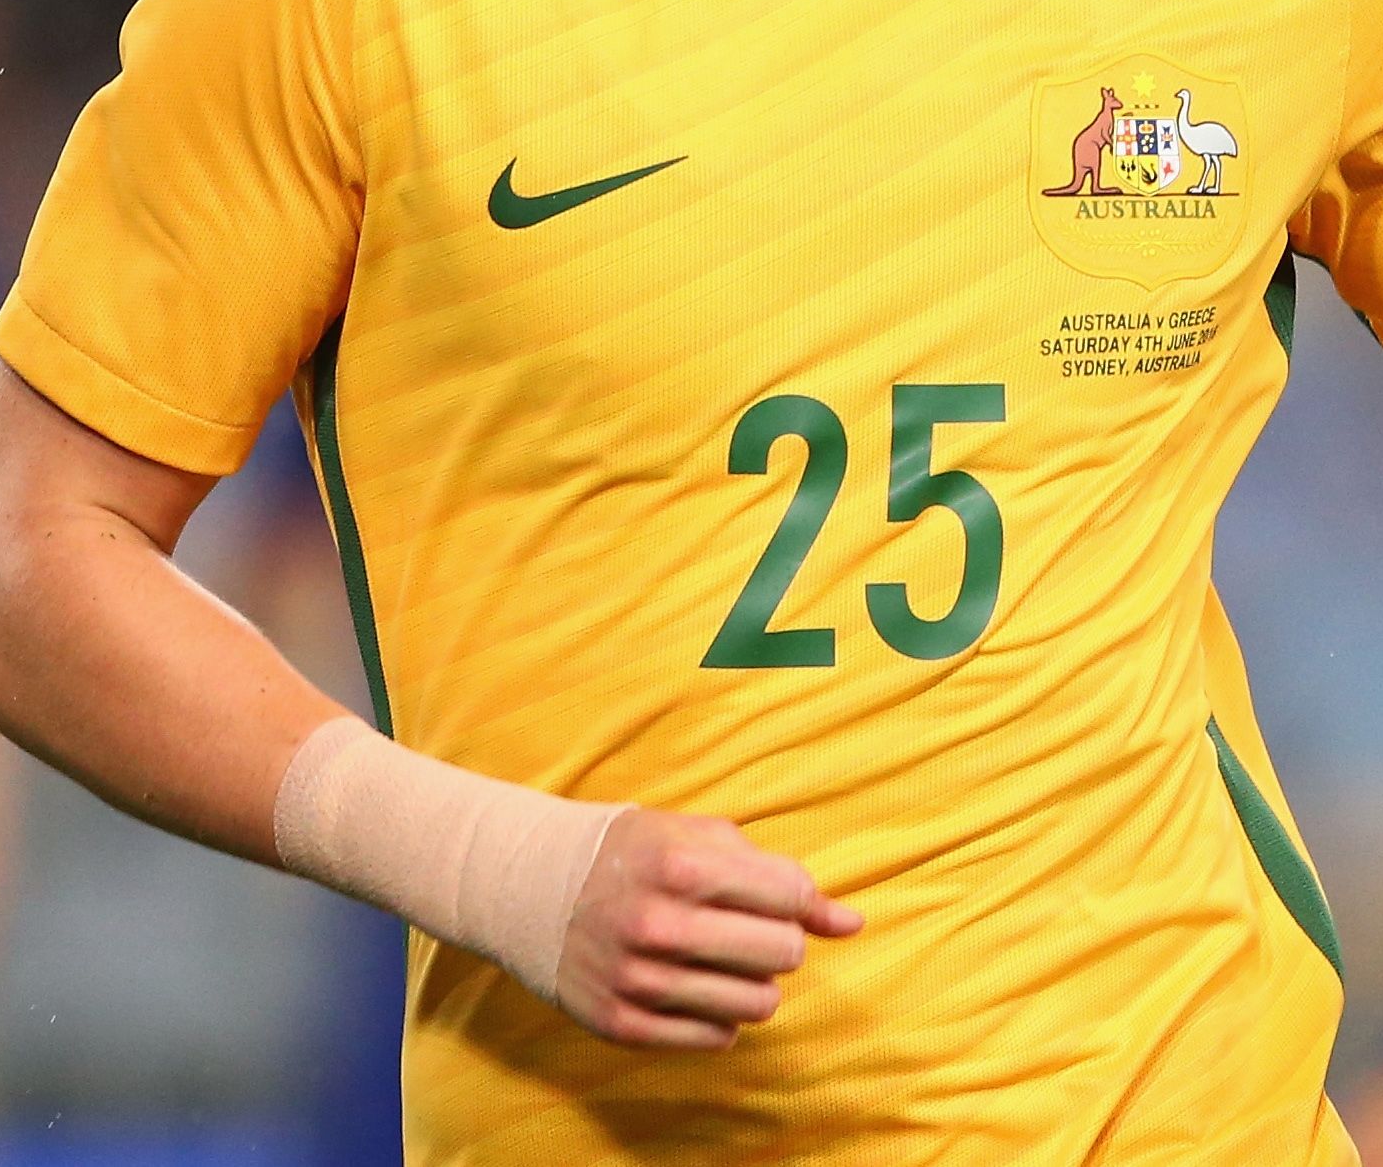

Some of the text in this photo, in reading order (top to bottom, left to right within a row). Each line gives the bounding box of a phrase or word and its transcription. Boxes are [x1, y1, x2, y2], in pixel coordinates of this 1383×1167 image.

[1075, 199, 1216, 219] AUSTRALIA
[1060, 313, 1151, 331] AUSTRALIA
[1169, 306, 1216, 329] GREECE
[1040, 336, 1131, 356] SATURDAY
[1134, 335, 1163, 352] 4TH
[1166, 331, 1197, 351] JUNE
[1062, 351, 1201, 377] SYDNEY, AUSTRALIA
[699, 383, 1007, 668] 25
